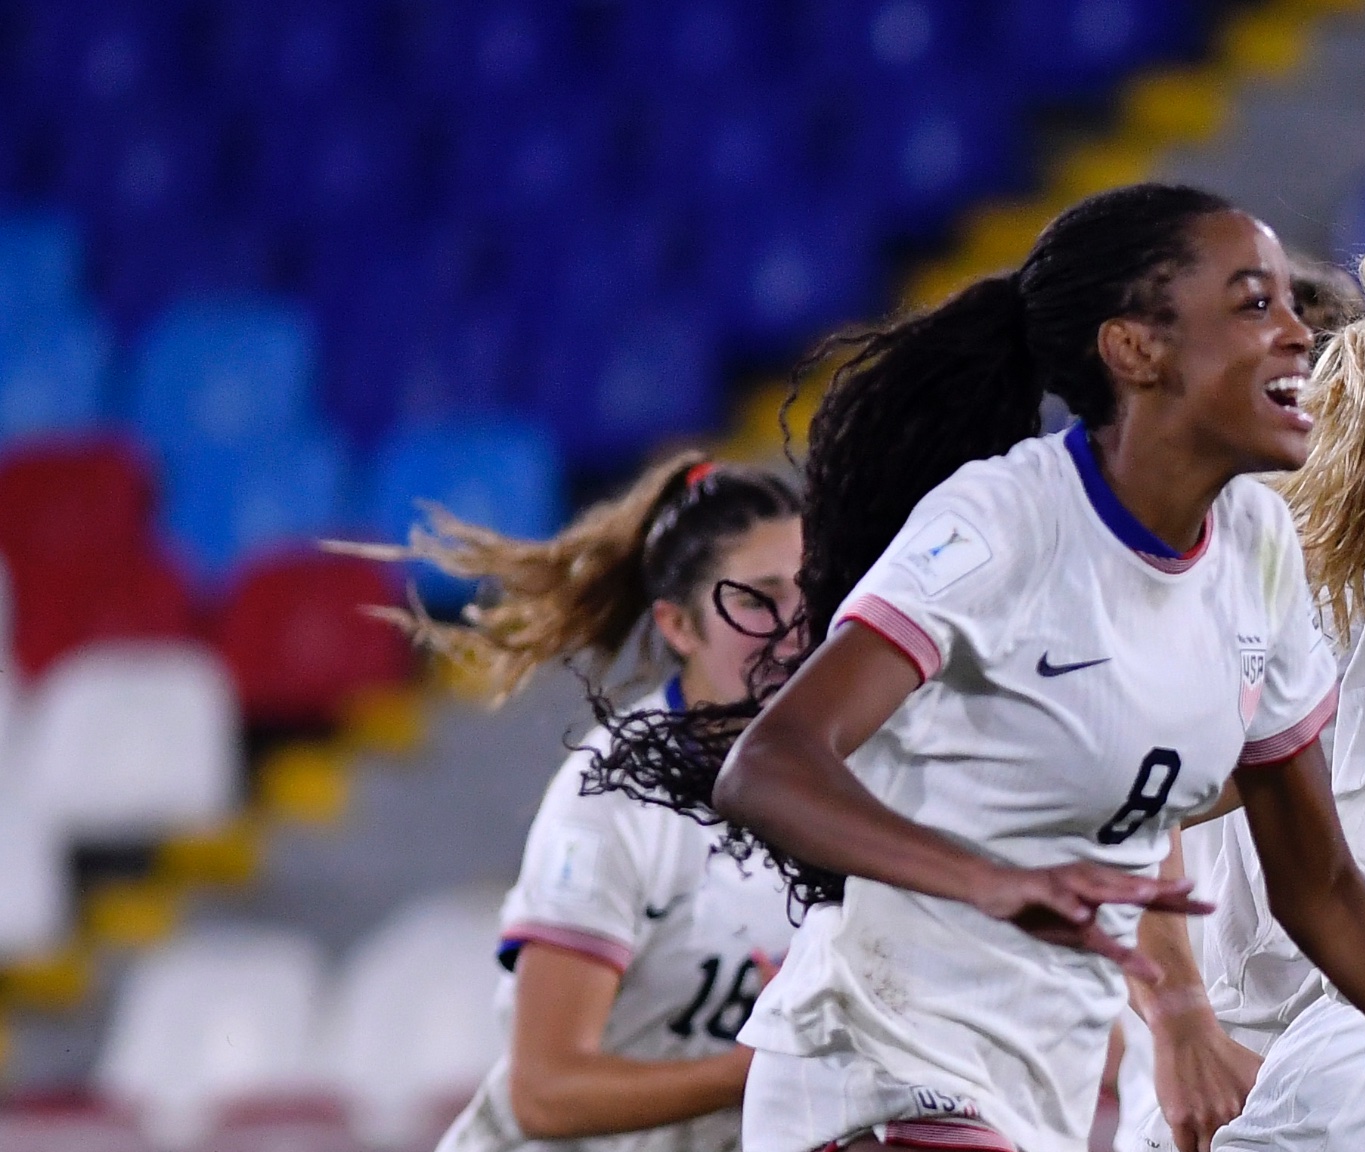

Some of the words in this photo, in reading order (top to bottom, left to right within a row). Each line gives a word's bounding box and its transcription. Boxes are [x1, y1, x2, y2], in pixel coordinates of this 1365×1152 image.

[1243, 654, 1264, 686] USA
[1096, 746, 1182, 845] 8
[918, 1089, 961, 1112] US
